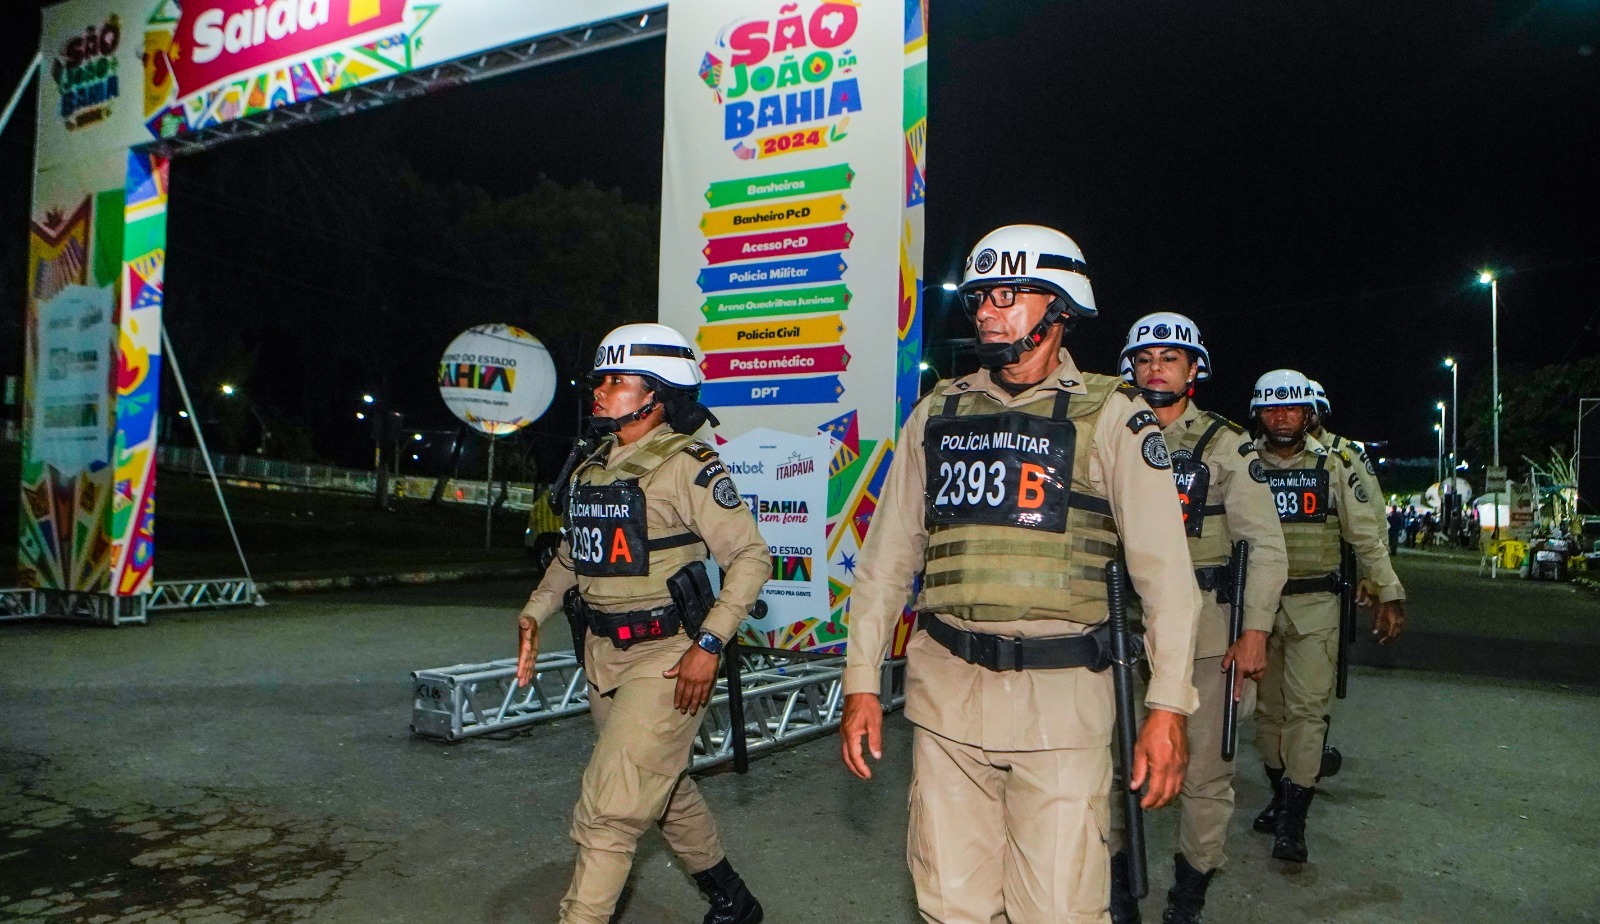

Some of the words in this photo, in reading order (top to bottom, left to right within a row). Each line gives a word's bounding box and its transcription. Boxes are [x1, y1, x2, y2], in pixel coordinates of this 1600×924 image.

[729, 2, 858, 67] SÃO
[727, 50, 834, 98] JOÃO
[838, 55, 857, 67] DA
[725, 77, 862, 140] BAHIA
[764, 131, 820, 154] 2024
[747, 180, 805, 195] Banheiros
[733, 208, 784, 225] Banheiro
[786, 207, 811, 219] PcD
[742, 238, 782, 253] Acesso
[784, 236, 809, 249] PcD
[729, 269, 768, 283] Polícia
[770, 267, 808, 279] Militar
[718, 303, 744, 311] Arena
[746, 298, 797, 310] Quadrilhas
[798, 295, 835, 306] Juninas
[737, 329, 776, 341] Polícia
[777, 327, 800, 338] Civil
[478, 355, 517, 367] ESTADO
[730, 357, 767, 370] Posto
[769, 355, 815, 368] médico
[751, 386, 779, 399] DPT
[940, 432, 990, 451] POLÍCIA
[992, 432, 1050, 455] MILITAR
[776, 459, 814, 480] ITAIPAVA
[935, 460, 1007, 507] 2393
[1018, 462, 1046, 509] B
[1287, 478, 1317, 487] MILITAR
[591, 504, 630, 518] MILITAR
[760, 500, 808, 513] BAHIA
[1277, 492, 1299, 514] 93
[1303, 492, 1317, 514] D
[759, 513, 782, 523] sem
[782, 512, 808, 525] fome
[610, 527, 633, 563] A
[779, 546, 812, 555] ESTADO
